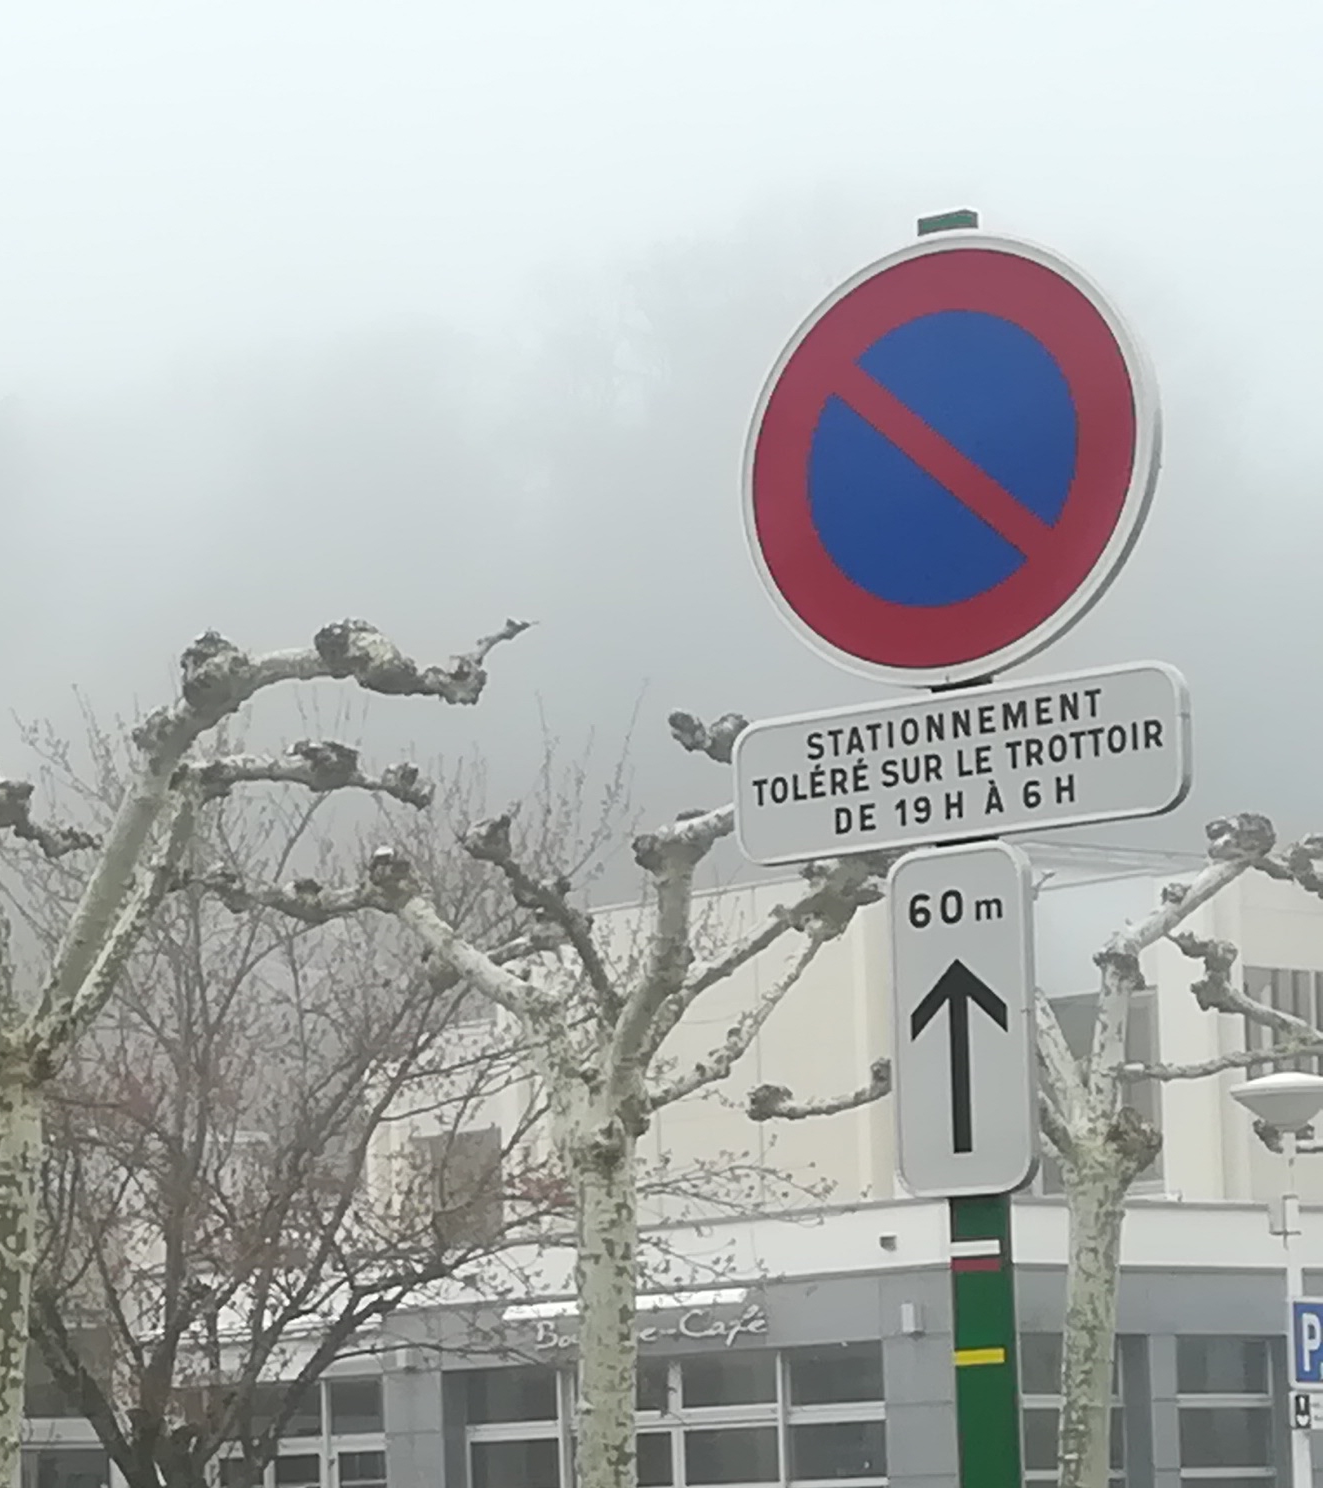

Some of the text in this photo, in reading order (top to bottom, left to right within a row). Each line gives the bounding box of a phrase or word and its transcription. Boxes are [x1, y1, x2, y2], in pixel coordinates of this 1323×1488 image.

[806, 688, 1102, 761] STATIONNEMENT
[752, 719, 1163, 807] TOLÉRÉ SUR LE TROTTOIR
[834, 802, 877, 835] DE
[984, 779, 1004, 815] À
[1301, 1311, 1322, 1373] P
